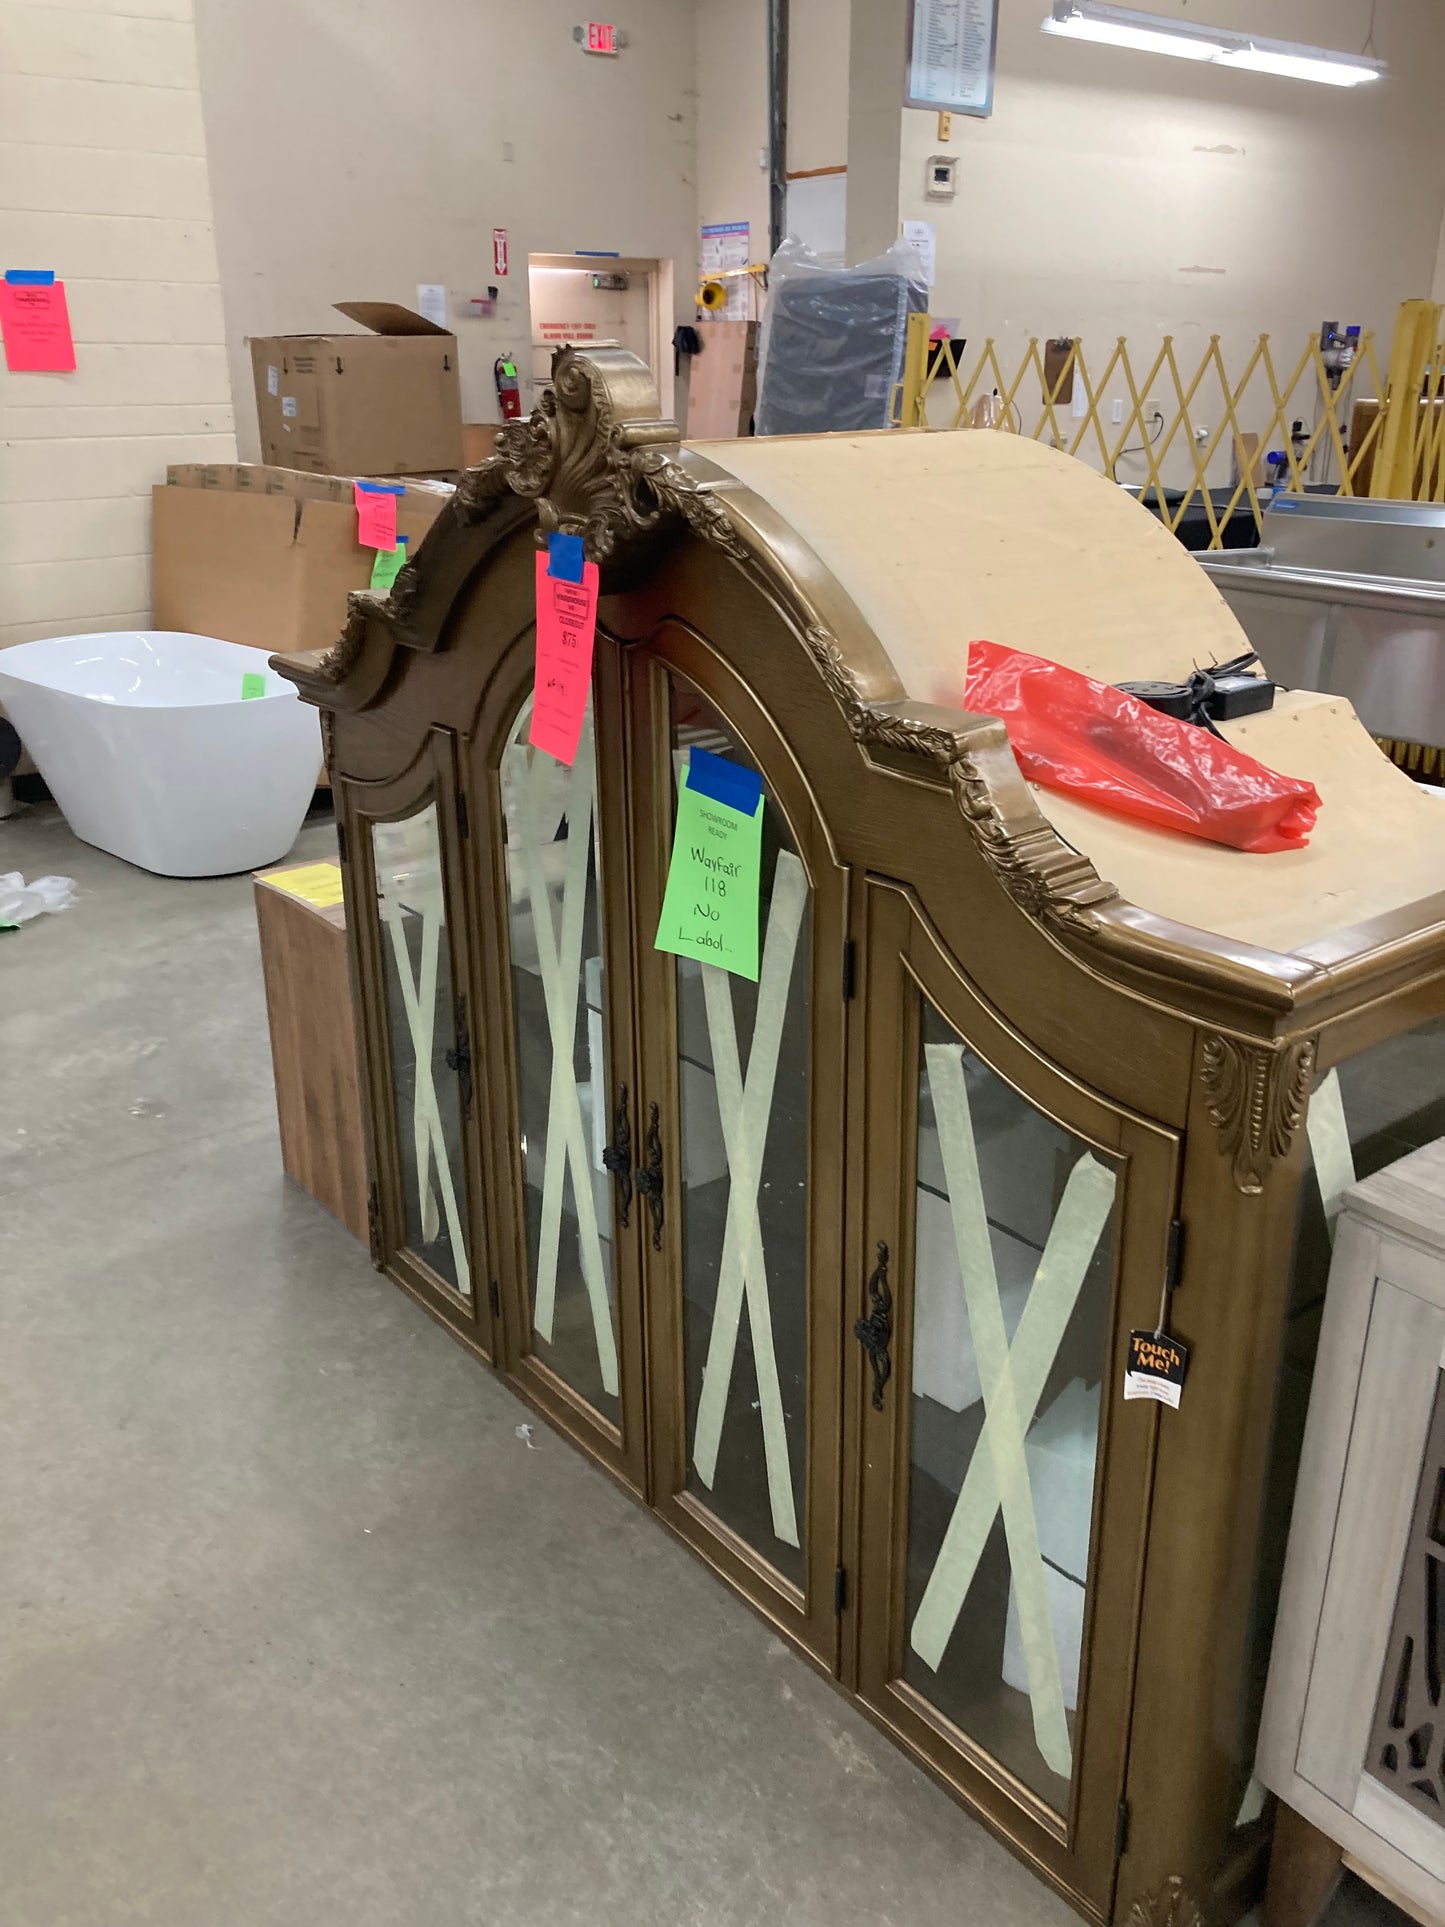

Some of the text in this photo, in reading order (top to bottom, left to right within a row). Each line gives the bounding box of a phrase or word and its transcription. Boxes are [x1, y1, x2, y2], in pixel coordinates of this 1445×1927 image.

[589, 23, 613, 50] EXIT
[700, 809, 738, 831] SHOWROOM
[708, 826, 728, 840] READY
[691, 847, 742, 878] Wayfair
[705, 876, 726, 897] 118
[694, 904, 720, 921] No
[1132, 1337, 1180, 1366] Touch
[1137, 1352, 1170, 1374] Me!
